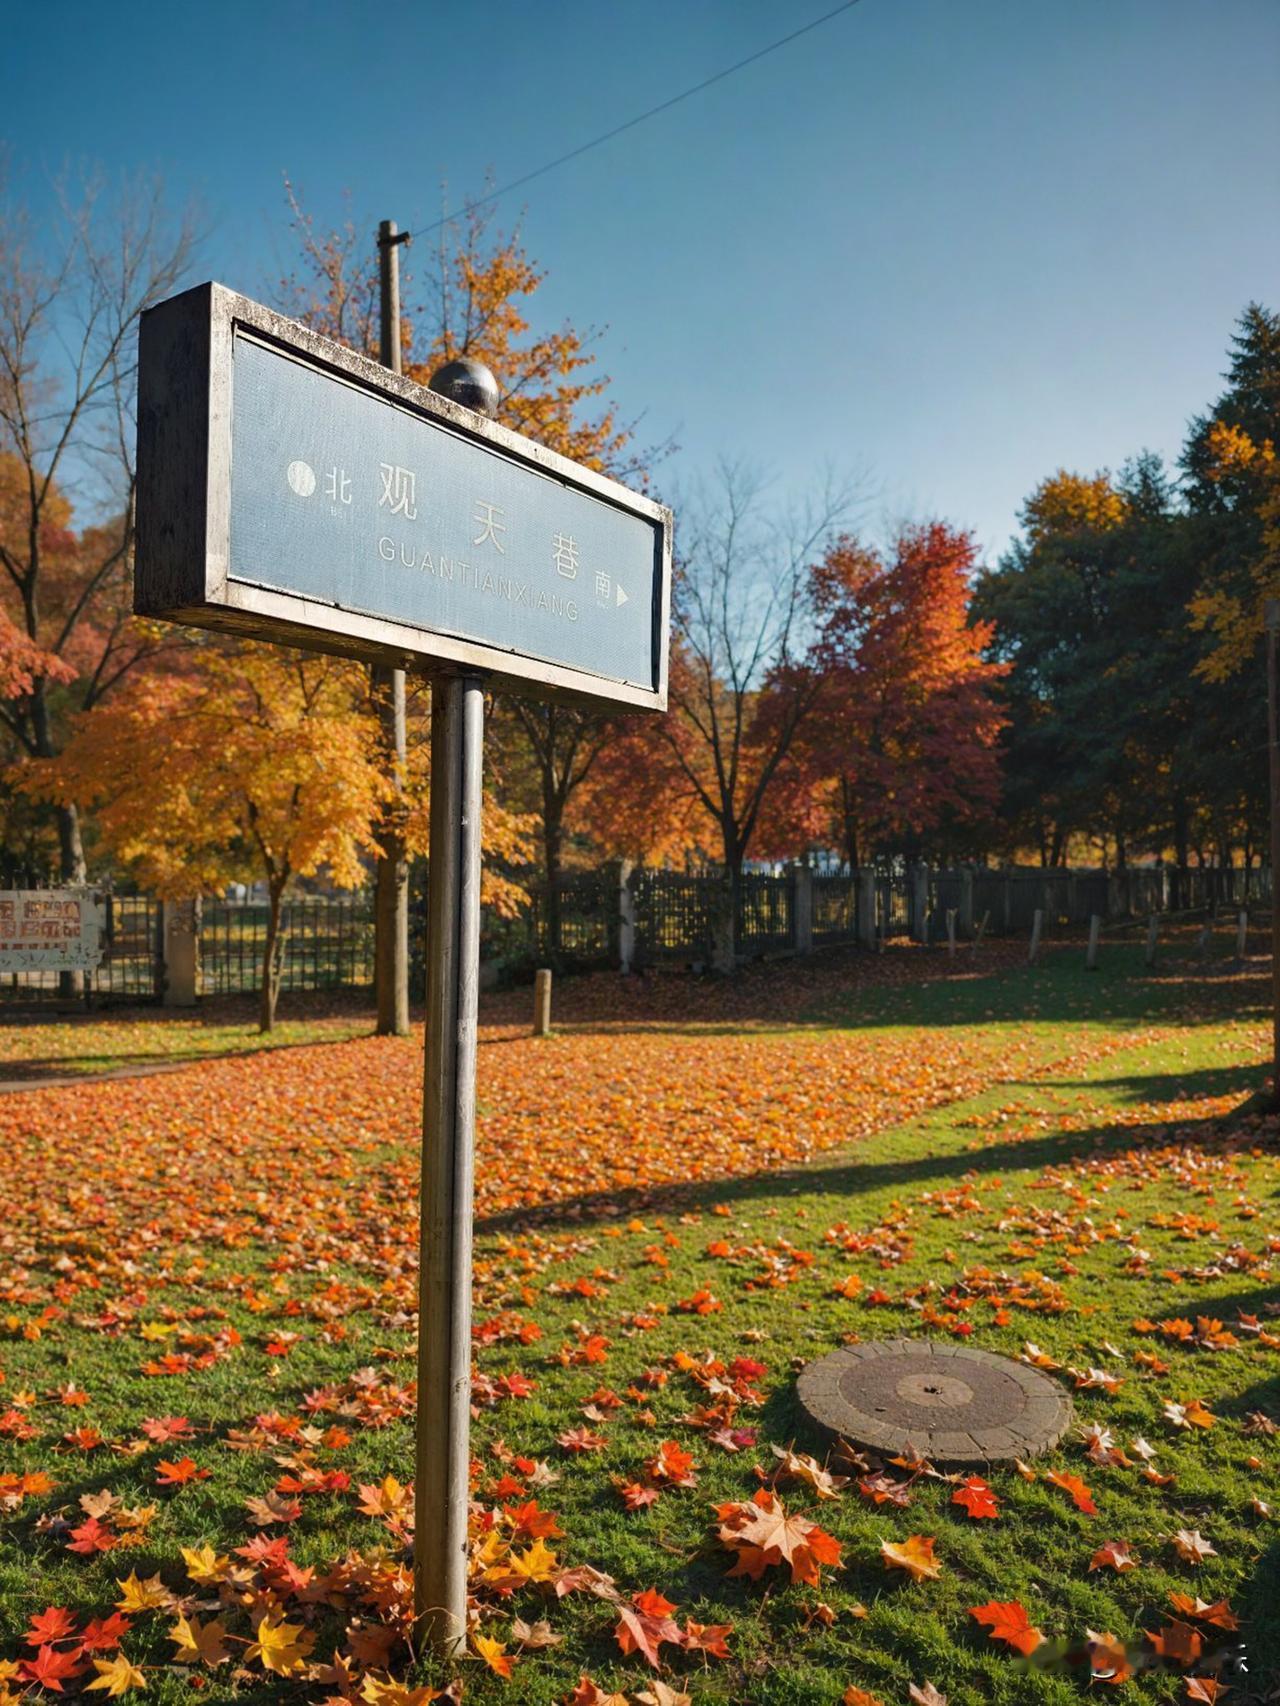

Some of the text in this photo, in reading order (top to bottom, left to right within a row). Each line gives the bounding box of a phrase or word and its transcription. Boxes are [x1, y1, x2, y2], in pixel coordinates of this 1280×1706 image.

[325, 462, 611, 599] 北 观天巷 南
[379, 536, 578, 622] GUANTIANXIANG
